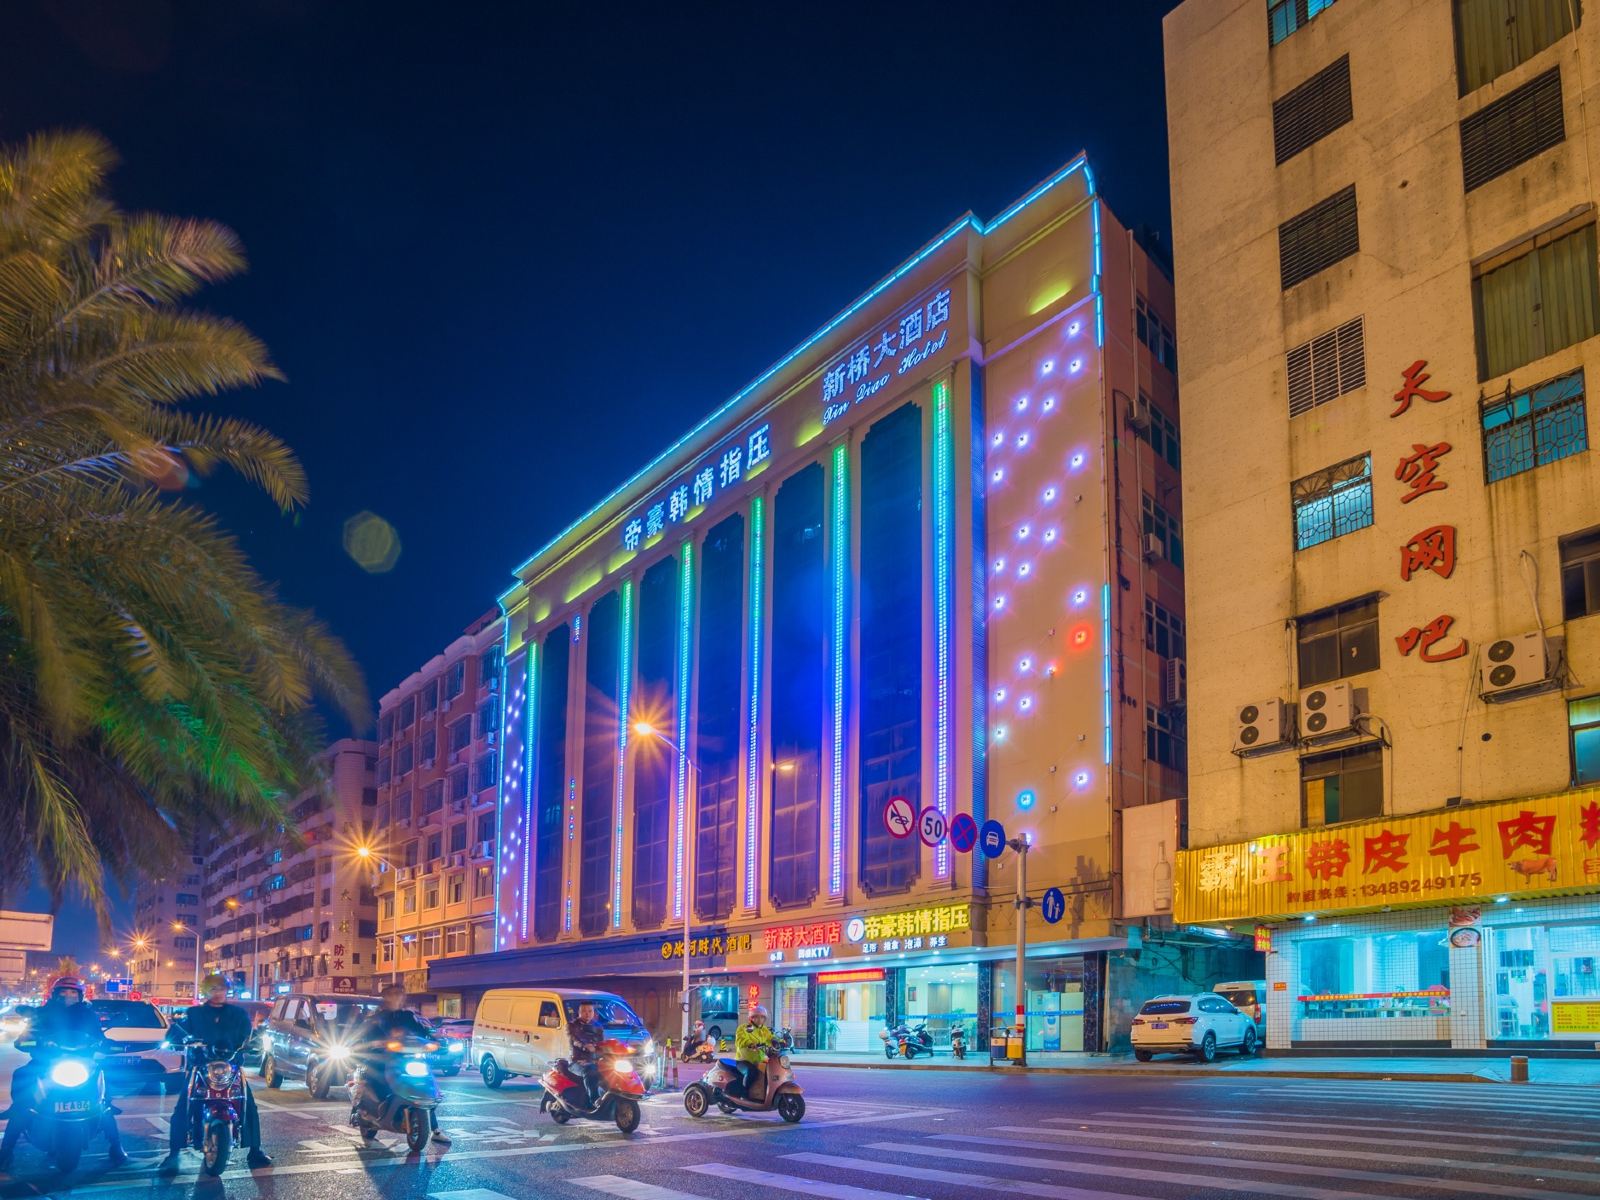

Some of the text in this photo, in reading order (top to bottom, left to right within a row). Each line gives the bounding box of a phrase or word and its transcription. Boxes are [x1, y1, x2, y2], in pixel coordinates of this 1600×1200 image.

[822, 288, 951, 402] 新桥大酒店
[823, 330, 949, 425] Xin Qiao Hotel
[624, 423, 770, 551] 帝豪韩情指压
[1390, 359, 1469, 663] 天空网吧
[925, 817, 943, 837] 50
[764, 921, 842, 949] 新桥大酒店
[865, 903, 970, 939] 帝豪韩情指压
[333, 944, 345, 971] 防水
